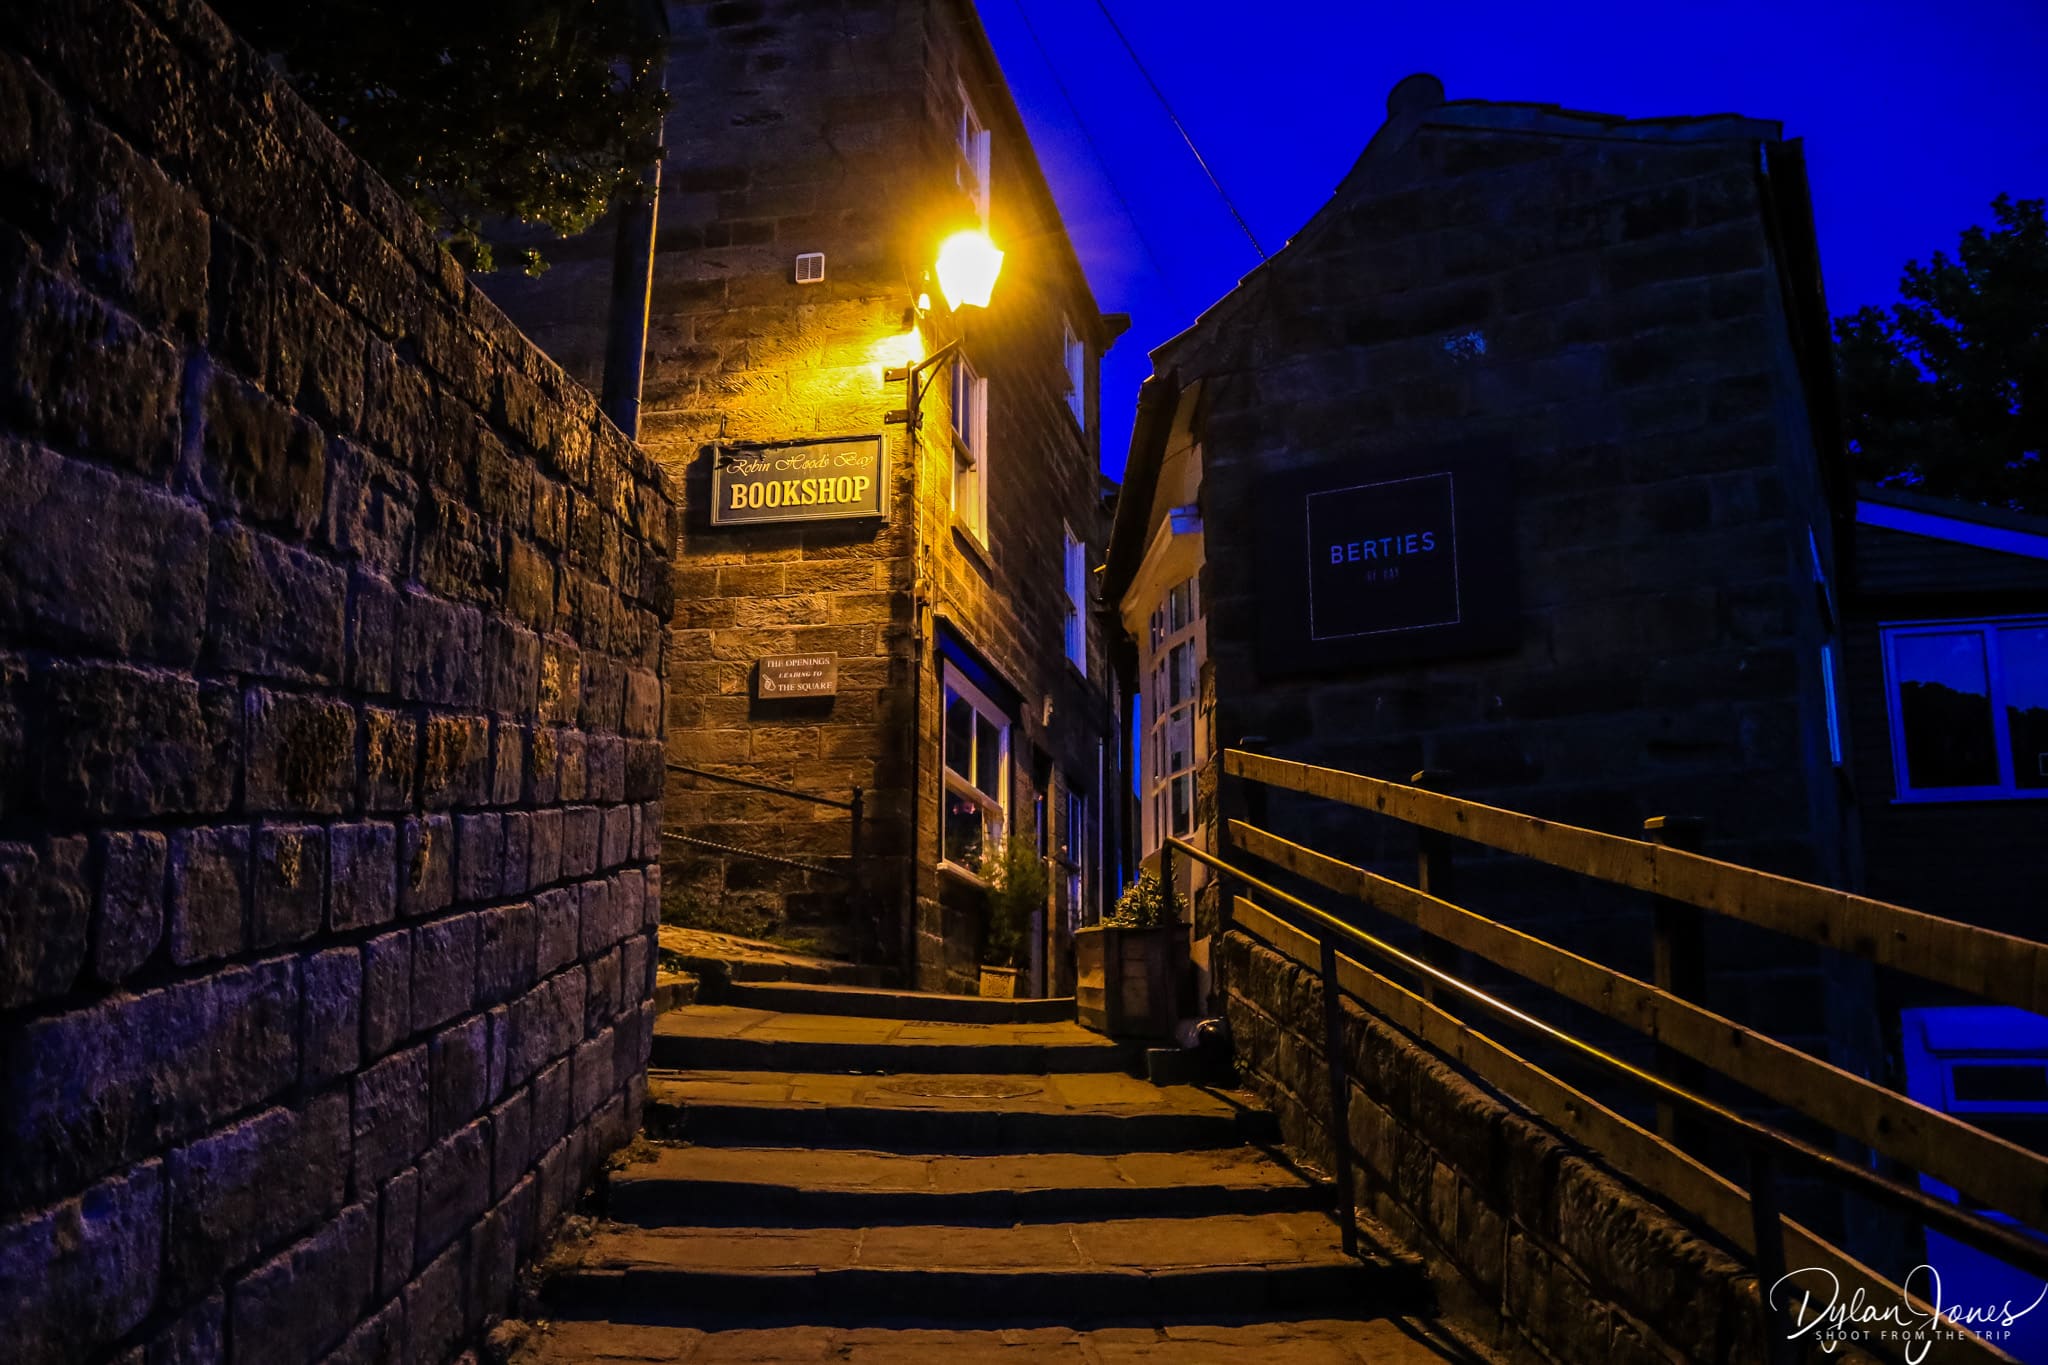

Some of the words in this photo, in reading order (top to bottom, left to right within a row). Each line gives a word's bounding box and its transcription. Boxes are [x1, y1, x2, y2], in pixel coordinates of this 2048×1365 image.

[726, 457, 770, 476] Robin
[833, 452, 874, 469] Bay
[730, 476, 870, 509] BOOKSHOP
[1330, 531, 1437, 565] BERTIES
[785, 657, 830, 667] OPENINGS
[778, 683, 796, 691] THE
[797, 681, 833, 691] SQUARE
